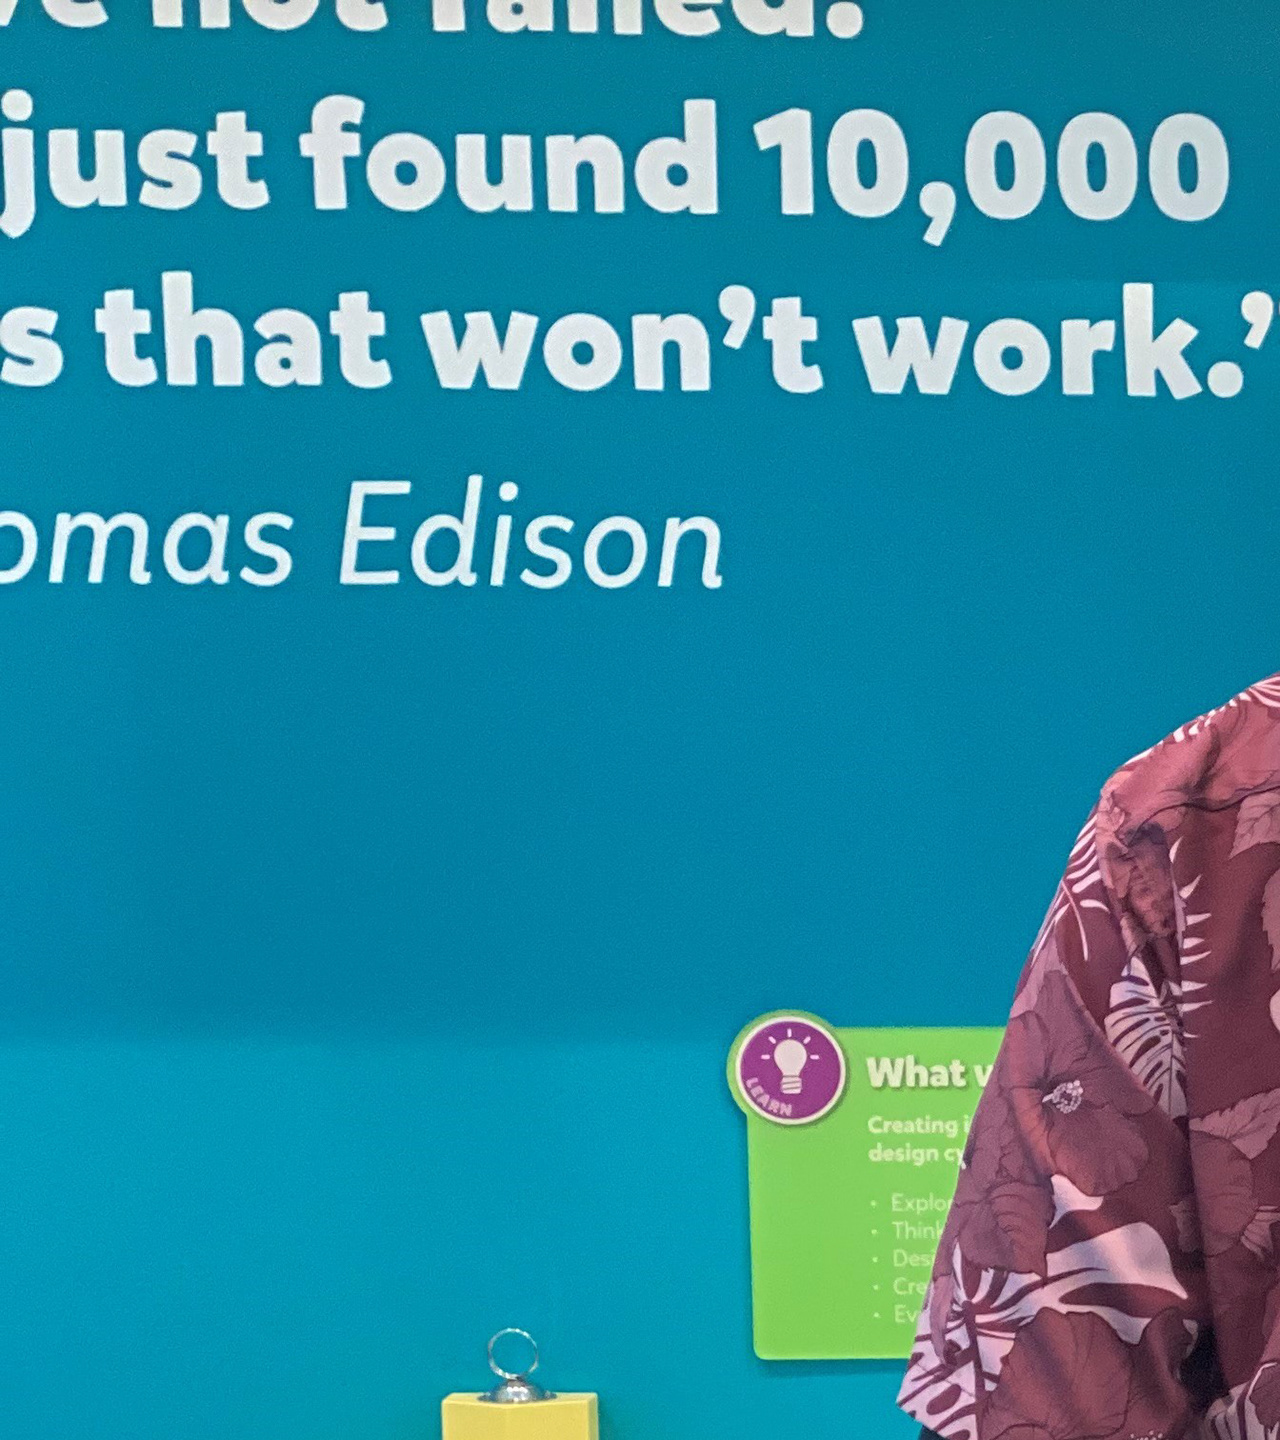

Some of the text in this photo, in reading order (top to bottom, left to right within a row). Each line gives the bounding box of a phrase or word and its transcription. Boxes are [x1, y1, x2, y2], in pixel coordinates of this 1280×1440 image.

[300, 94, 718, 214] found
[753, 107, 1230, 247] 10,000
[95, 271, 393, 388] that
[420, 285, 823, 393] won’t
[340, 474, 723, 589] Edison
[866, 1055, 967, 1088] What
[745, 1077, 793, 1117] LEARN
[867, 1115, 960, 1138] Creating
[867, 1143, 939, 1166] design
